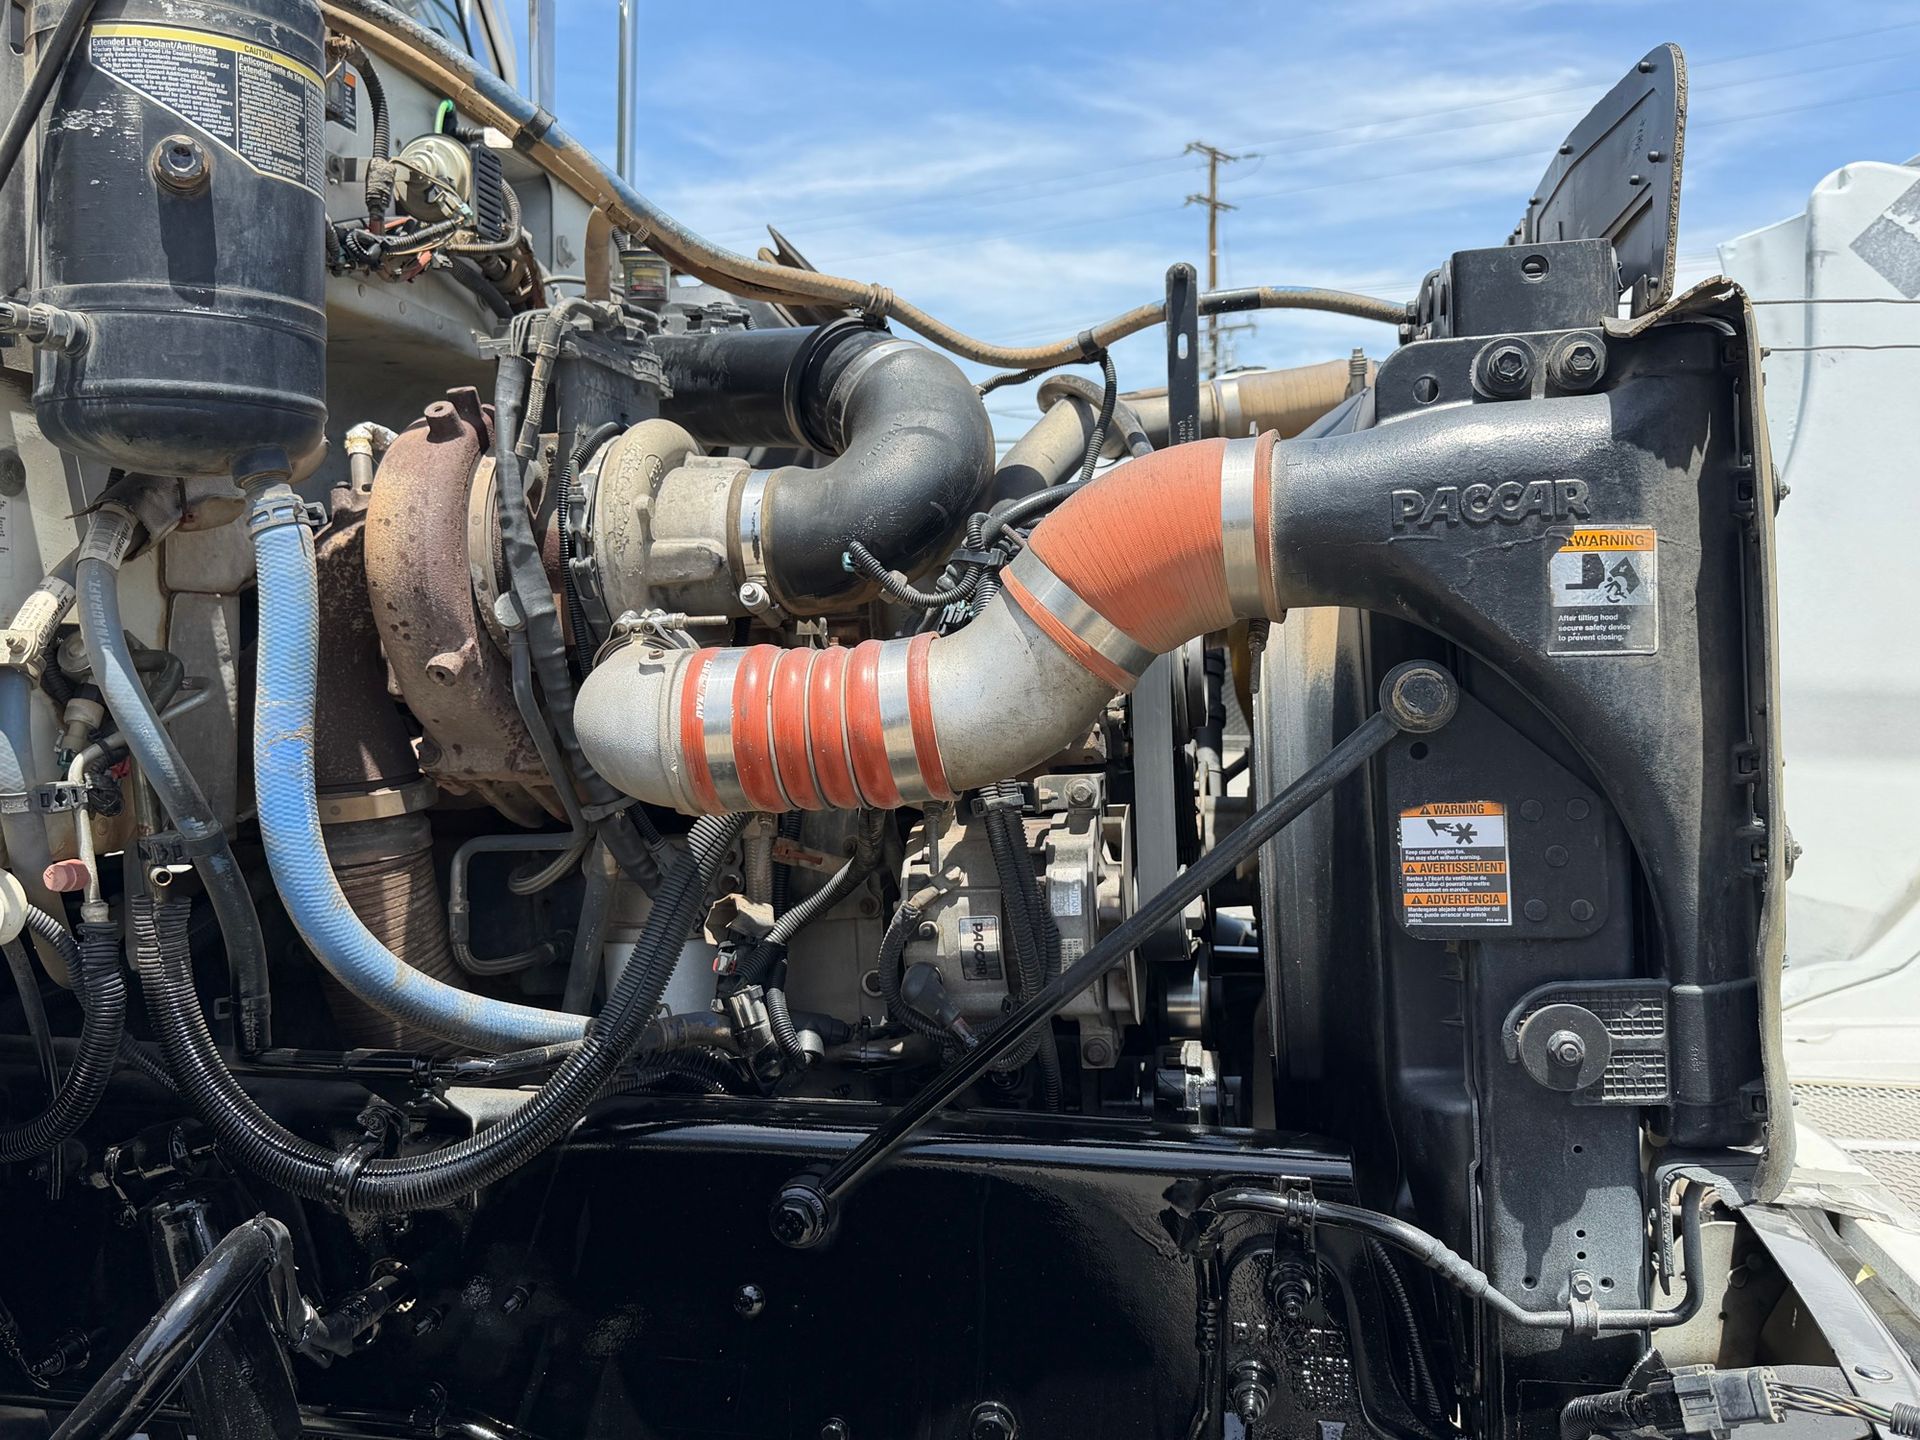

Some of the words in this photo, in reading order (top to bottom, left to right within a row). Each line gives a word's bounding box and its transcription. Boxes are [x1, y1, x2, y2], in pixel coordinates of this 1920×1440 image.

[92, 38, 126, 46] Extended
[127, 38, 142, 46] Life
[143, 39, 217, 56] Coolant/Antifreeze
[244, 45, 272, 60] CAUTION
[239, 54, 286, 77] Anticongelante
[239, 63, 272, 81] Extendida
[1391, 481, 1591, 528] PACCAR
[1574, 534, 1645, 546] WARNING
[1578, 614, 1598, 622] tilting
[1433, 804, 1485, 814] WARNING
[1420, 862, 1504, 873] AVERTISSEMENT
[1426, 894, 1500, 904] ADVERTENCIA
[972, 922, 988, 976] PACCAR
